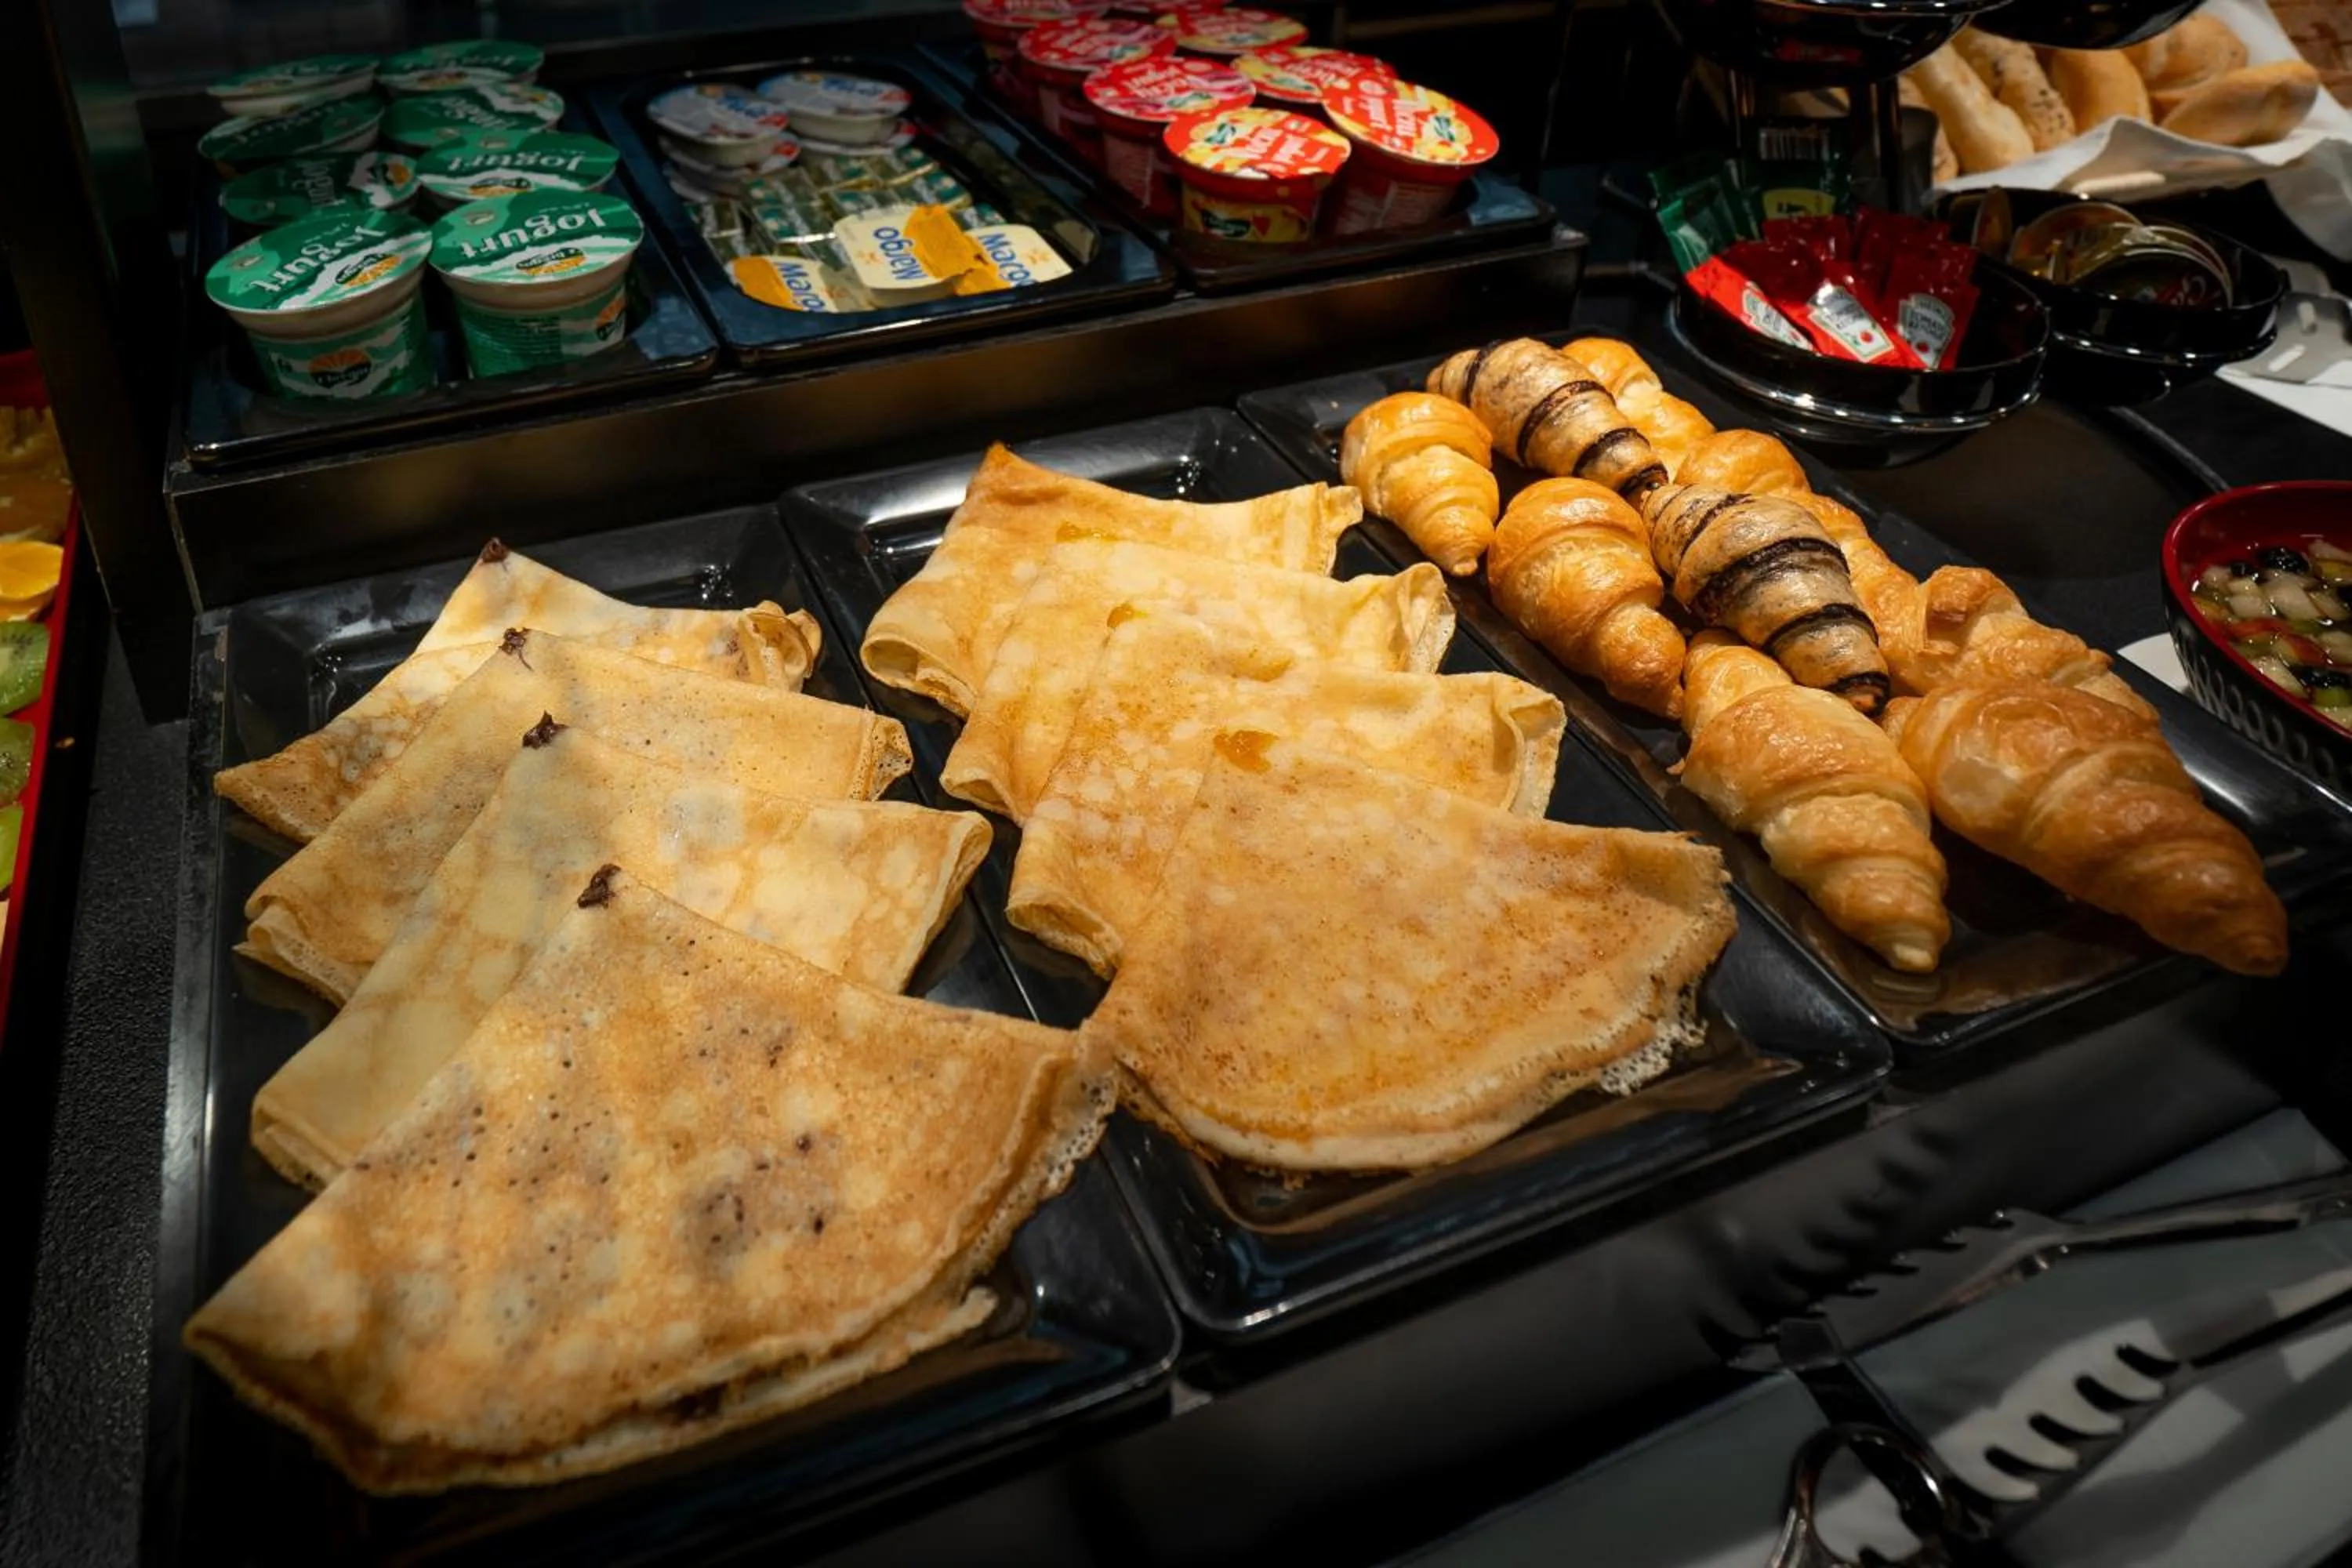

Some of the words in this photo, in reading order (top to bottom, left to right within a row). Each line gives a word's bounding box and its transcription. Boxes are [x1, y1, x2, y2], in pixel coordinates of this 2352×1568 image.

[447, 151, 584, 172] Jogurt
[250, 225, 387, 293] Jogurt
[459, 207, 603, 259] Jogurt
[873, 227, 929, 279] Margo
[978, 234, 1036, 287] Marg
[775, 262, 826, 312] Marg
